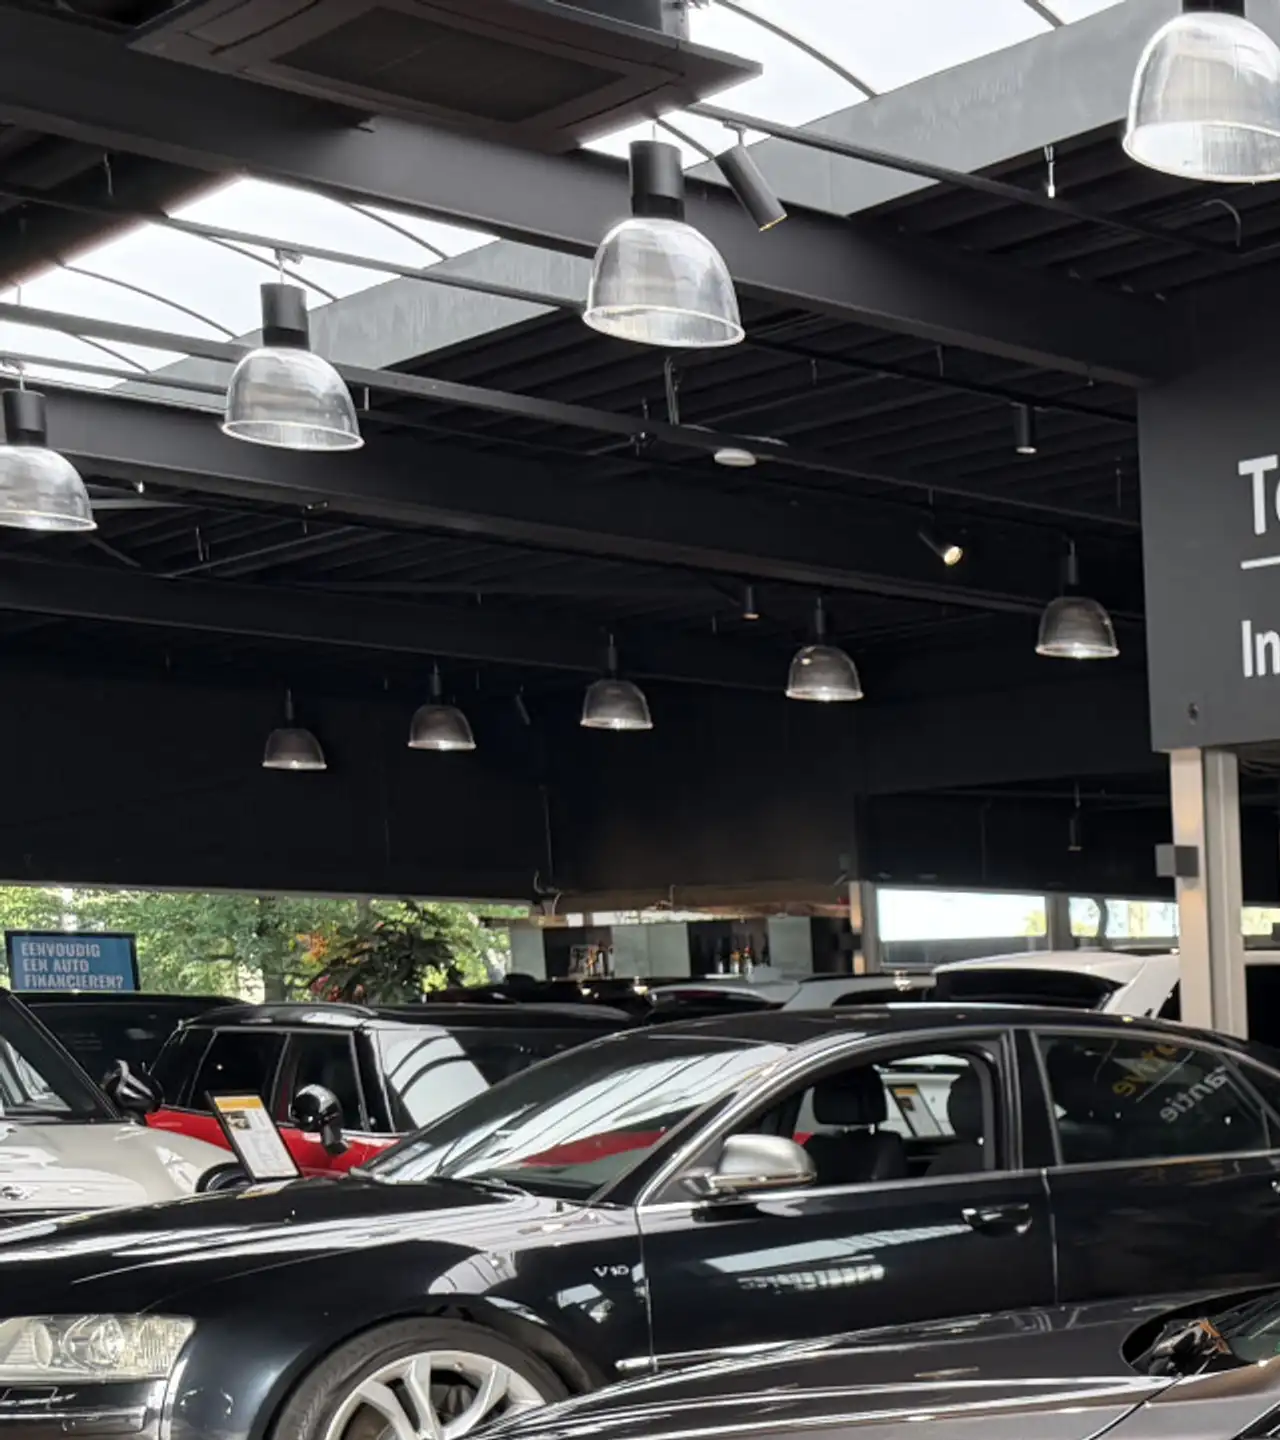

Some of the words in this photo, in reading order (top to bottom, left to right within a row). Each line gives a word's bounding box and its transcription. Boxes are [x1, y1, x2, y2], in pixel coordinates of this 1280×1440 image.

[21, 942, 101, 957] EENVOUDIG
[23, 959, 48, 972] EEN
[54, 959, 90, 973] AUTO
[24, 974, 124, 989] FINANCIEREN?
[593, 1264, 630, 1278] V10
